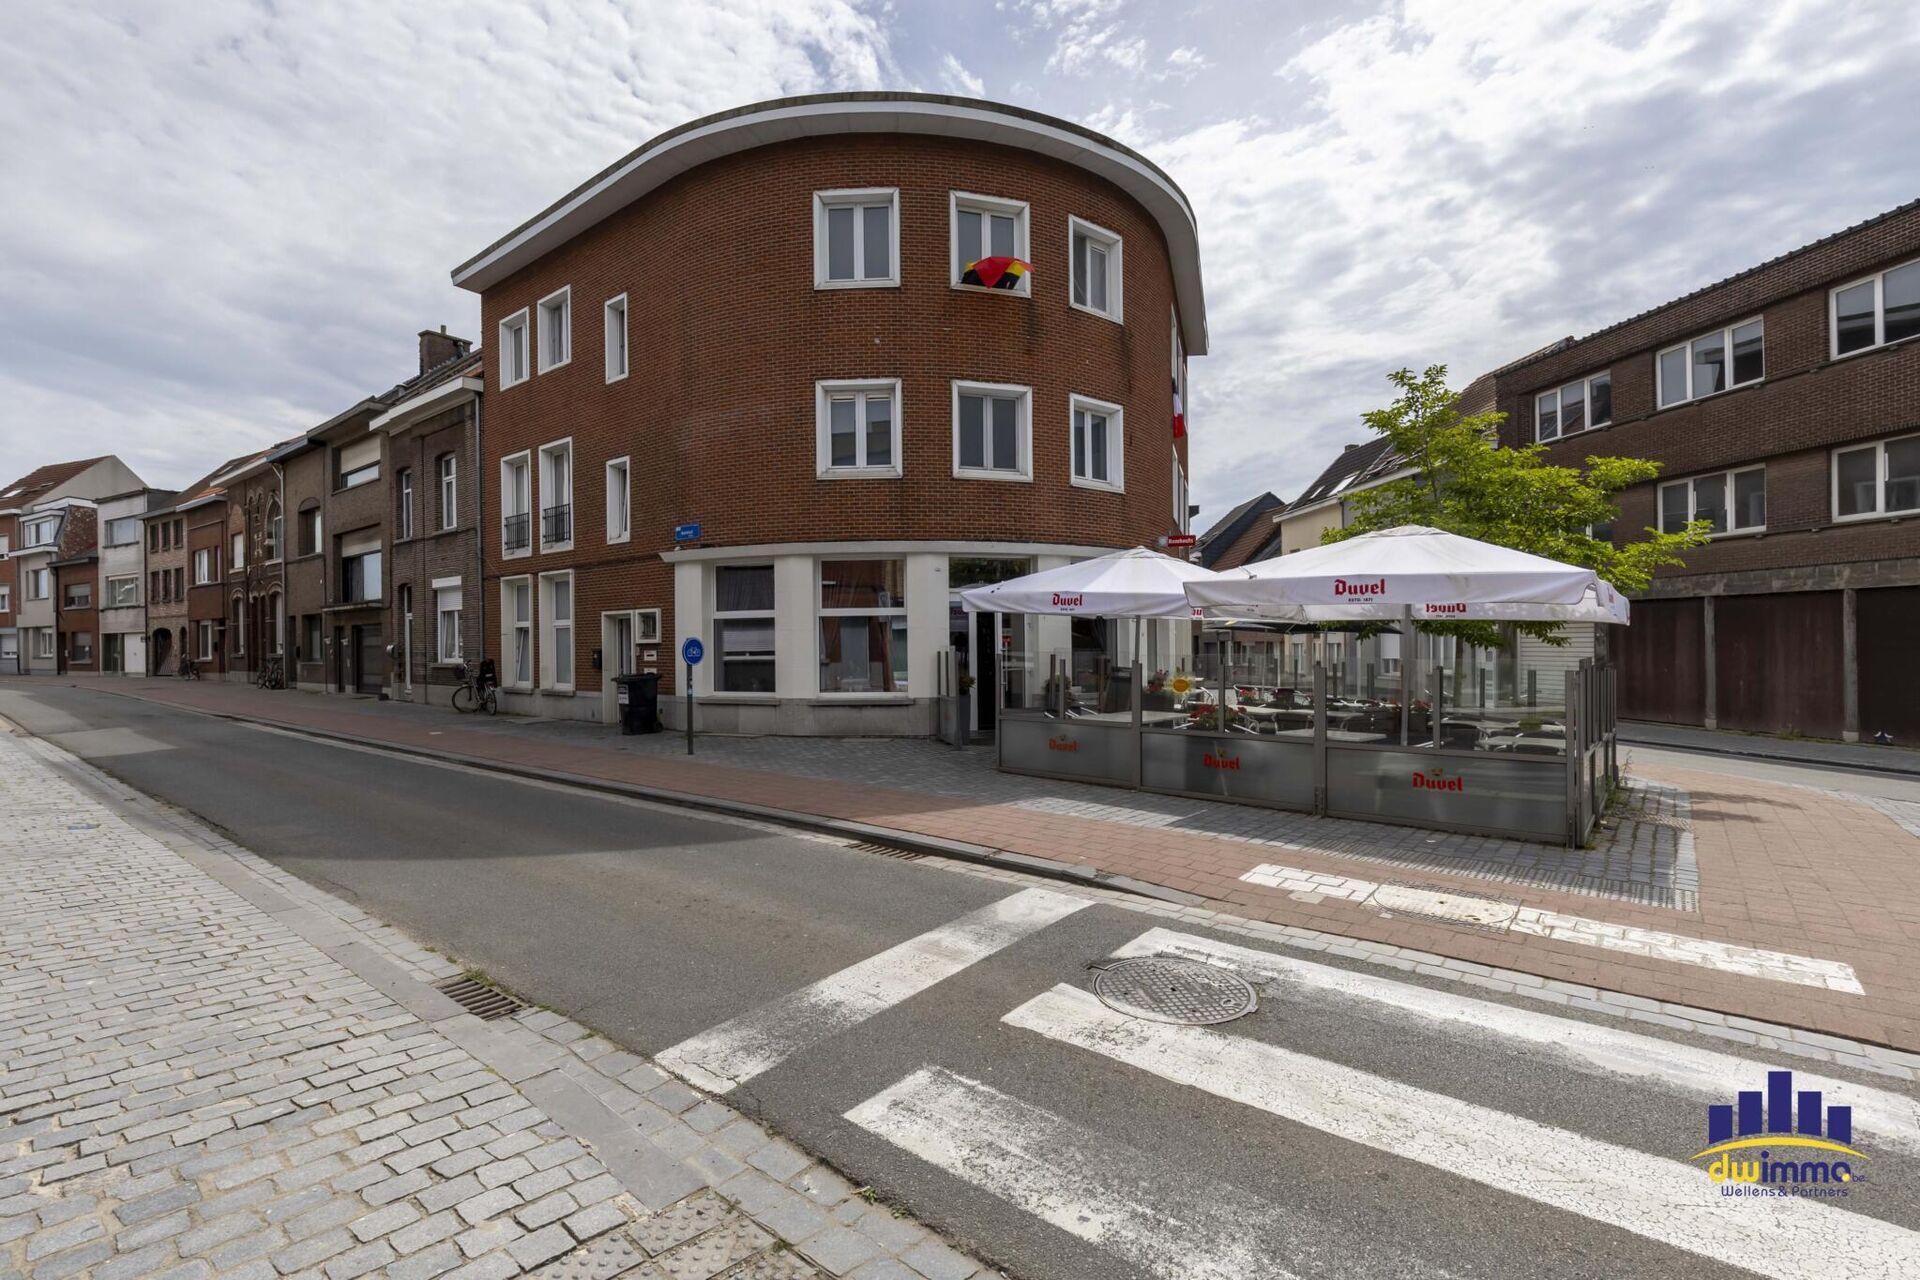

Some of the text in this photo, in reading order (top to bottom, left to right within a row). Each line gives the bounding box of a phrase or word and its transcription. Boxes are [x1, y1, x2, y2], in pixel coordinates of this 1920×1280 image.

[1334, 578, 1386, 596] Duvel
[1052, 593, 1083, 606] Duvel
[1049, 739, 1078, 752] Duvel
[1203, 753, 1241, 770] Duvel
[1412, 771, 1464, 792] Duvel
